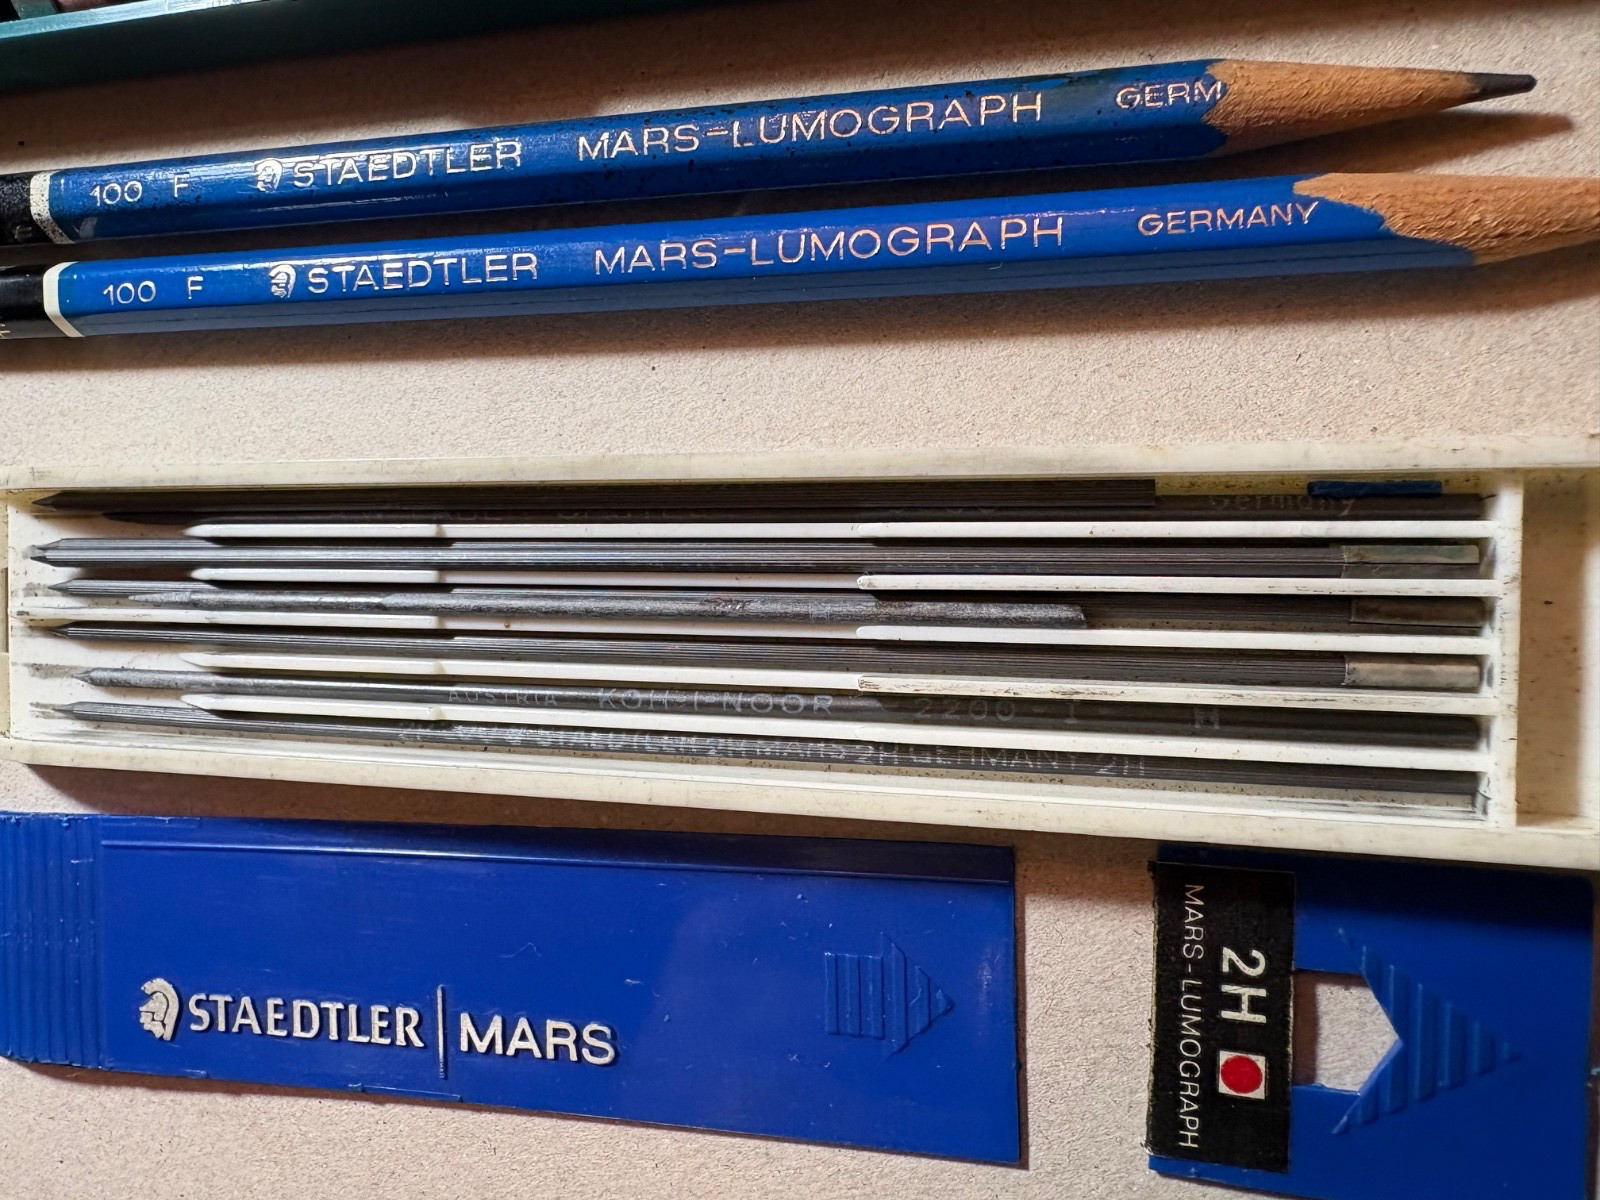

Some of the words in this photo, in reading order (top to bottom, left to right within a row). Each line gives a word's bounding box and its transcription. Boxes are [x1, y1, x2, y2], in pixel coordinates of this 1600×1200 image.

[90, 180, 143, 207] 100
[173, 172, 192, 198] F
[293, 140, 523, 188] STAEDTLER
[577, 92, 1042, 162] MARS-LUMOGRAPH
[1116, 80, 1223, 110] GERM
[102, 280, 156, 306] 100
[187, 275, 204, 300] F
[307, 251, 538, 294] STAEDTLER
[594, 216, 1064, 275] MARS-LUMOGRAPH
[1137, 200, 1319, 237] GERMANY
[188, 993, 425, 1048] STAEDTLER
[459, 1012, 617, 1066] MARS
[1220, 946, 1267, 1024] 2H
